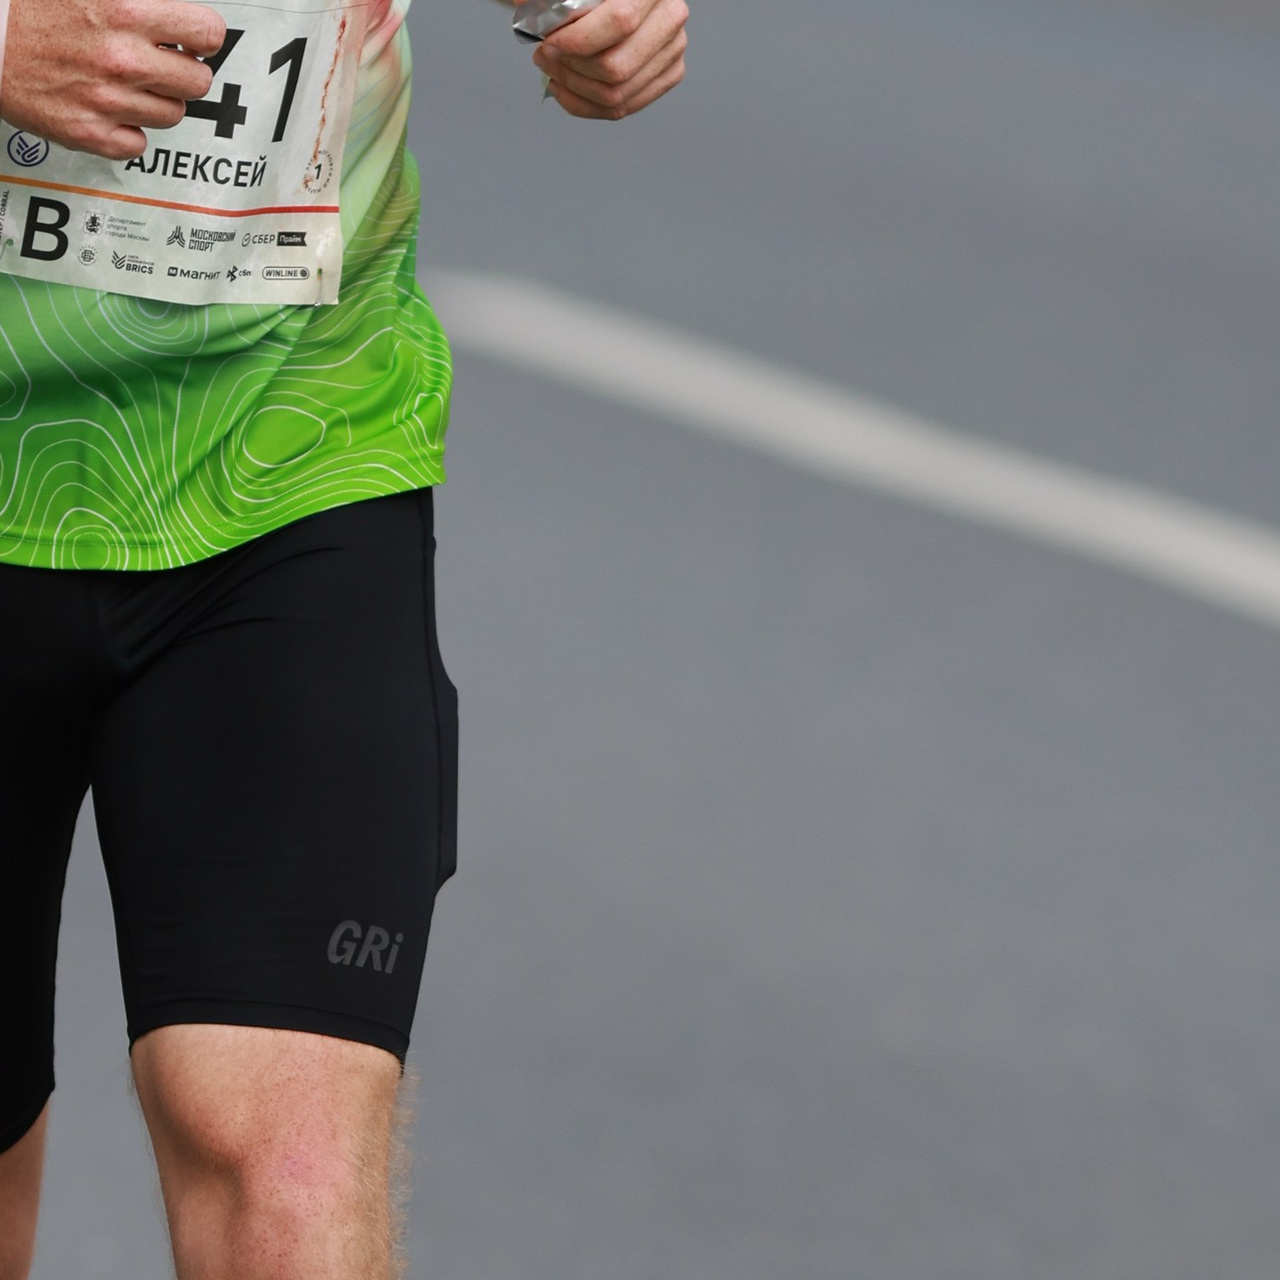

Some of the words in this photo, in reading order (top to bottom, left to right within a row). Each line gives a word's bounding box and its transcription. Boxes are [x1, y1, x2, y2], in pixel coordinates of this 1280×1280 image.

[160, 27, 308, 144] 41
[124, 147, 267, 188] АЛЕКСЕЙ
[0, 189, 10, 217] CORRAL
[188, 239, 214, 252] СПОРТ
[252, 234, 276, 244] СБЕР
[125, 263, 154, 275] BRICS
[265, 269, 299, 278] WINLINE
